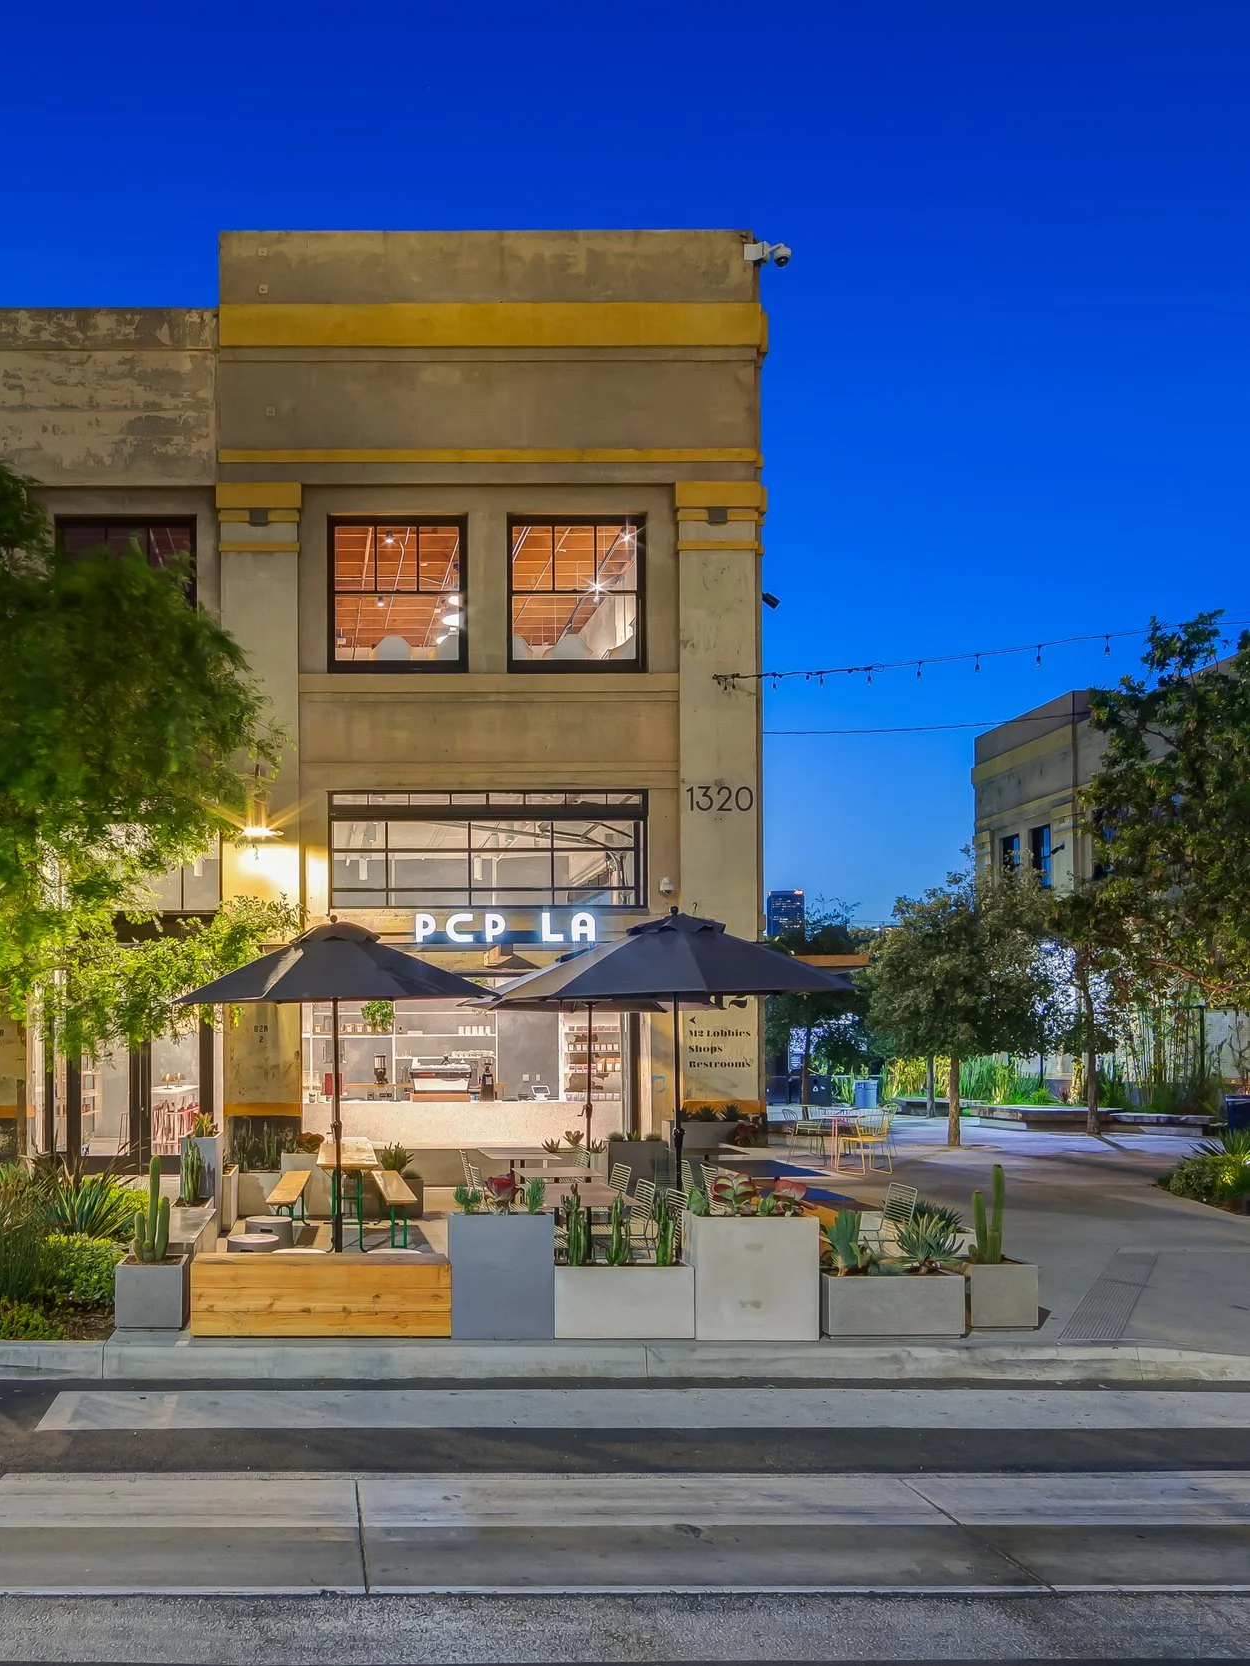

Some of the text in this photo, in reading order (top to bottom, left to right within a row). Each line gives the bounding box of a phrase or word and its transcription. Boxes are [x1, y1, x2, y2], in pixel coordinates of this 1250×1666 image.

[685, 786, 754, 812] 1320
[415, 911, 596, 943] PCP LA
[688, 1029, 751, 1037] M2 Lobbies
[688, 1044, 723, 1054] Shops
[688, 1060, 751, 1068] Restrooms
